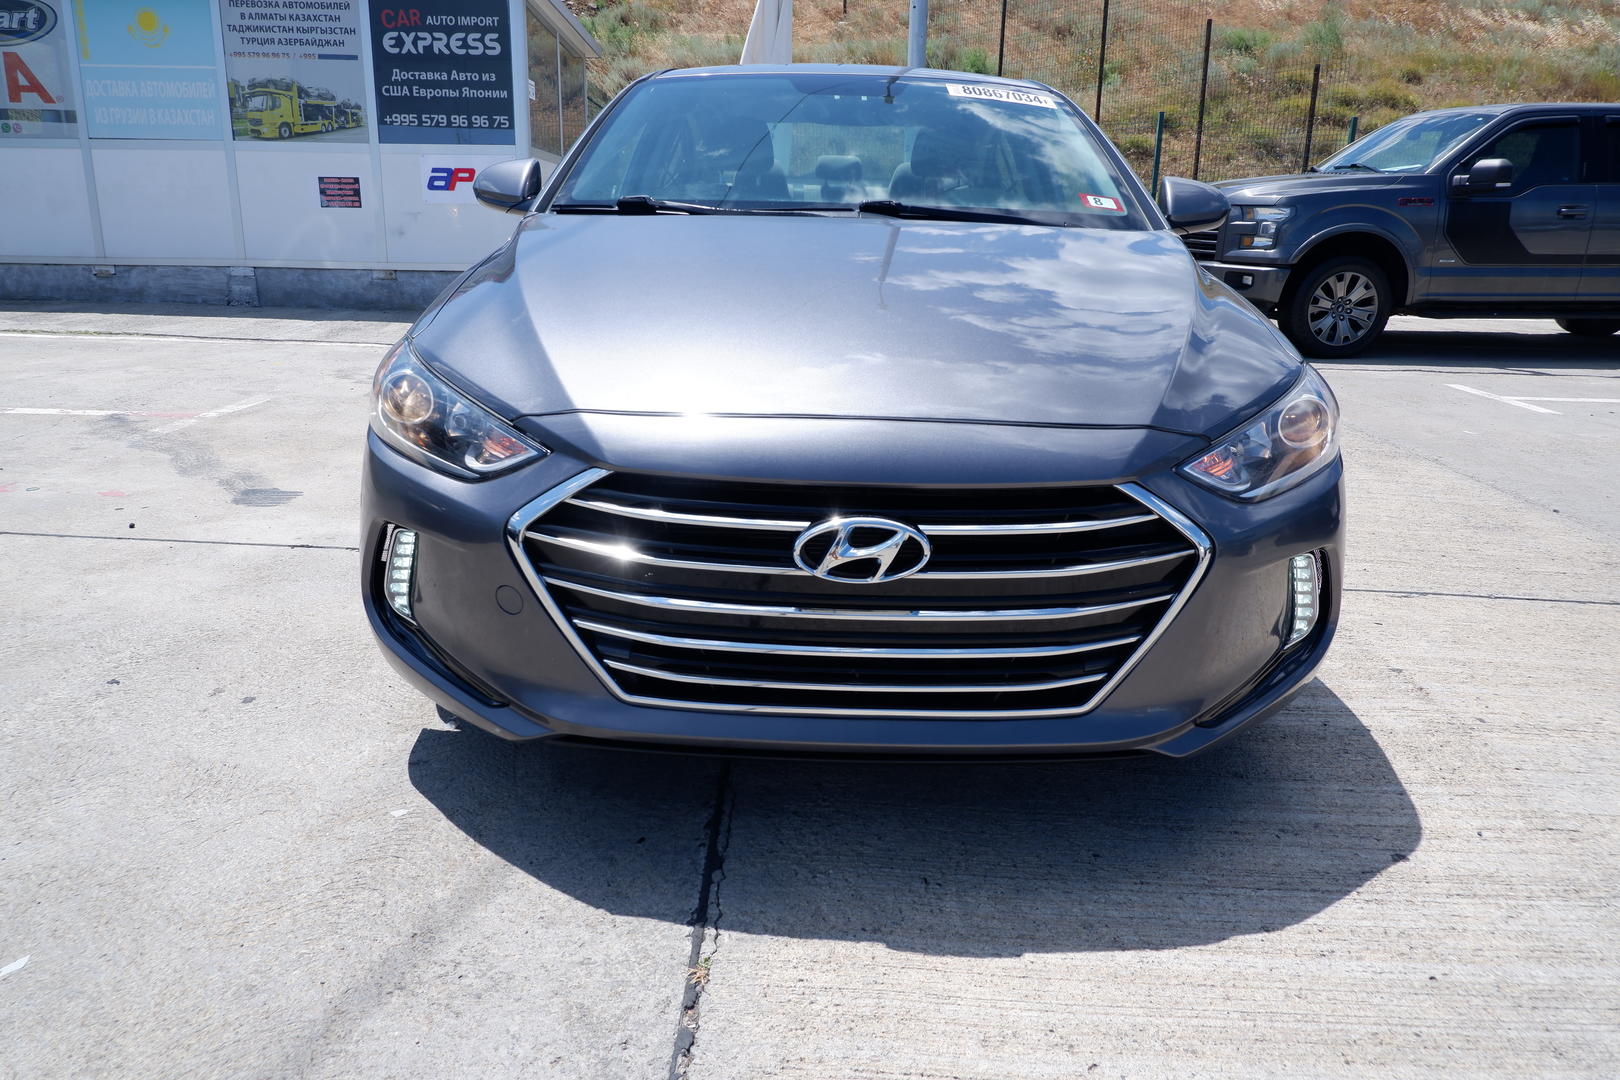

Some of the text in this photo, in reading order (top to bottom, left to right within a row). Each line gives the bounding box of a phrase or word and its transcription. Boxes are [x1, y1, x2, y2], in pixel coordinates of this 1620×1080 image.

[228, 0, 351, 11] ПЕРЕВОЗКА АВТОМОБИЛЕЙ
[240, 12, 341, 23] В АЛМАТЫ КАЗАХСТАН
[380, 9, 500, 28] CAR AUTO IMPORT
[227, 24, 356, 36] ТАДЖИКИСТАН КЫРГЫЗСТАН
[240, 36, 345, 48] ТУРЦИЯ АЗЕРБАЙДЖАН
[382, 31, 502, 56] EXPRESS
[3, 52, 57, 104] A
[391, 69, 496, 82] Доставка Авто из
[381, 85, 508, 99] США Европы Японии
[383, 114, 510, 128] +995 579 96 96 75
[1093, 197, 1103, 206] 8
